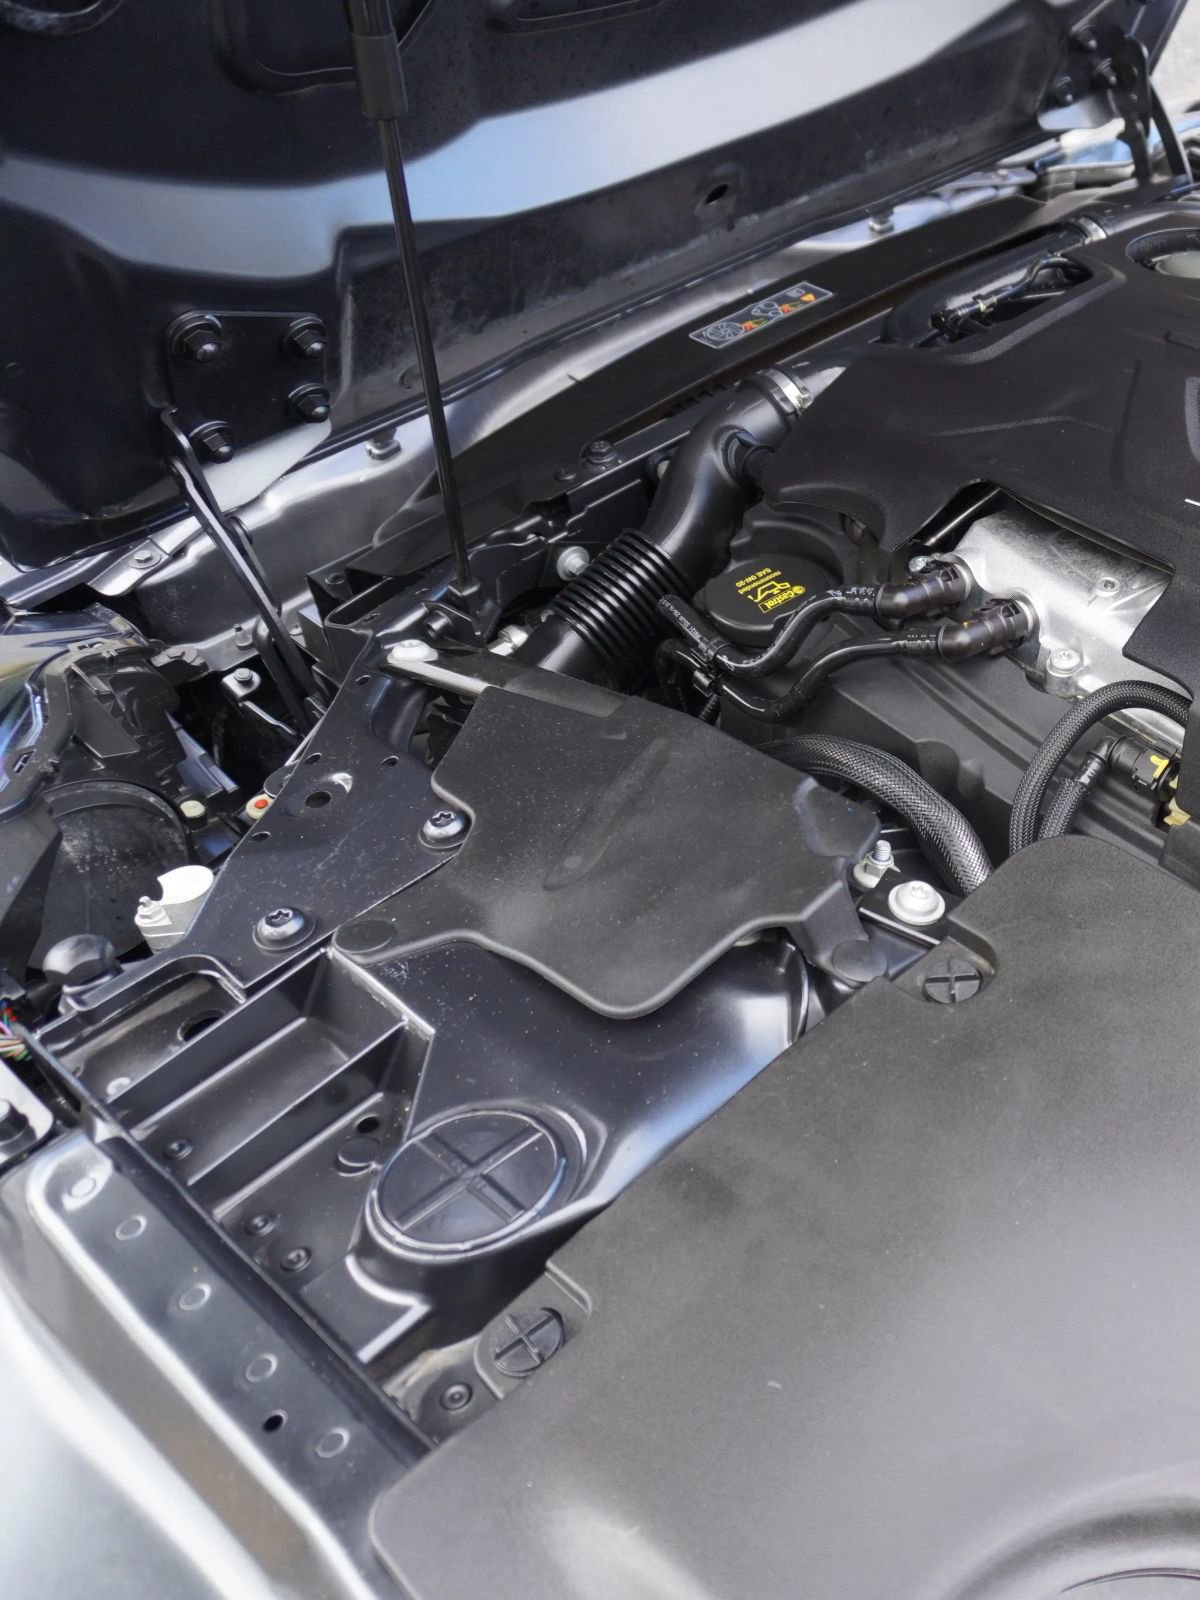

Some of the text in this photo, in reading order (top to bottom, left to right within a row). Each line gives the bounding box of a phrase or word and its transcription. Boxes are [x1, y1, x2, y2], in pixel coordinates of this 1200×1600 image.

[755, 567, 772, 578] SAE
[737, 570, 782, 595] recommended
[764, 590, 795, 609] Castrol
